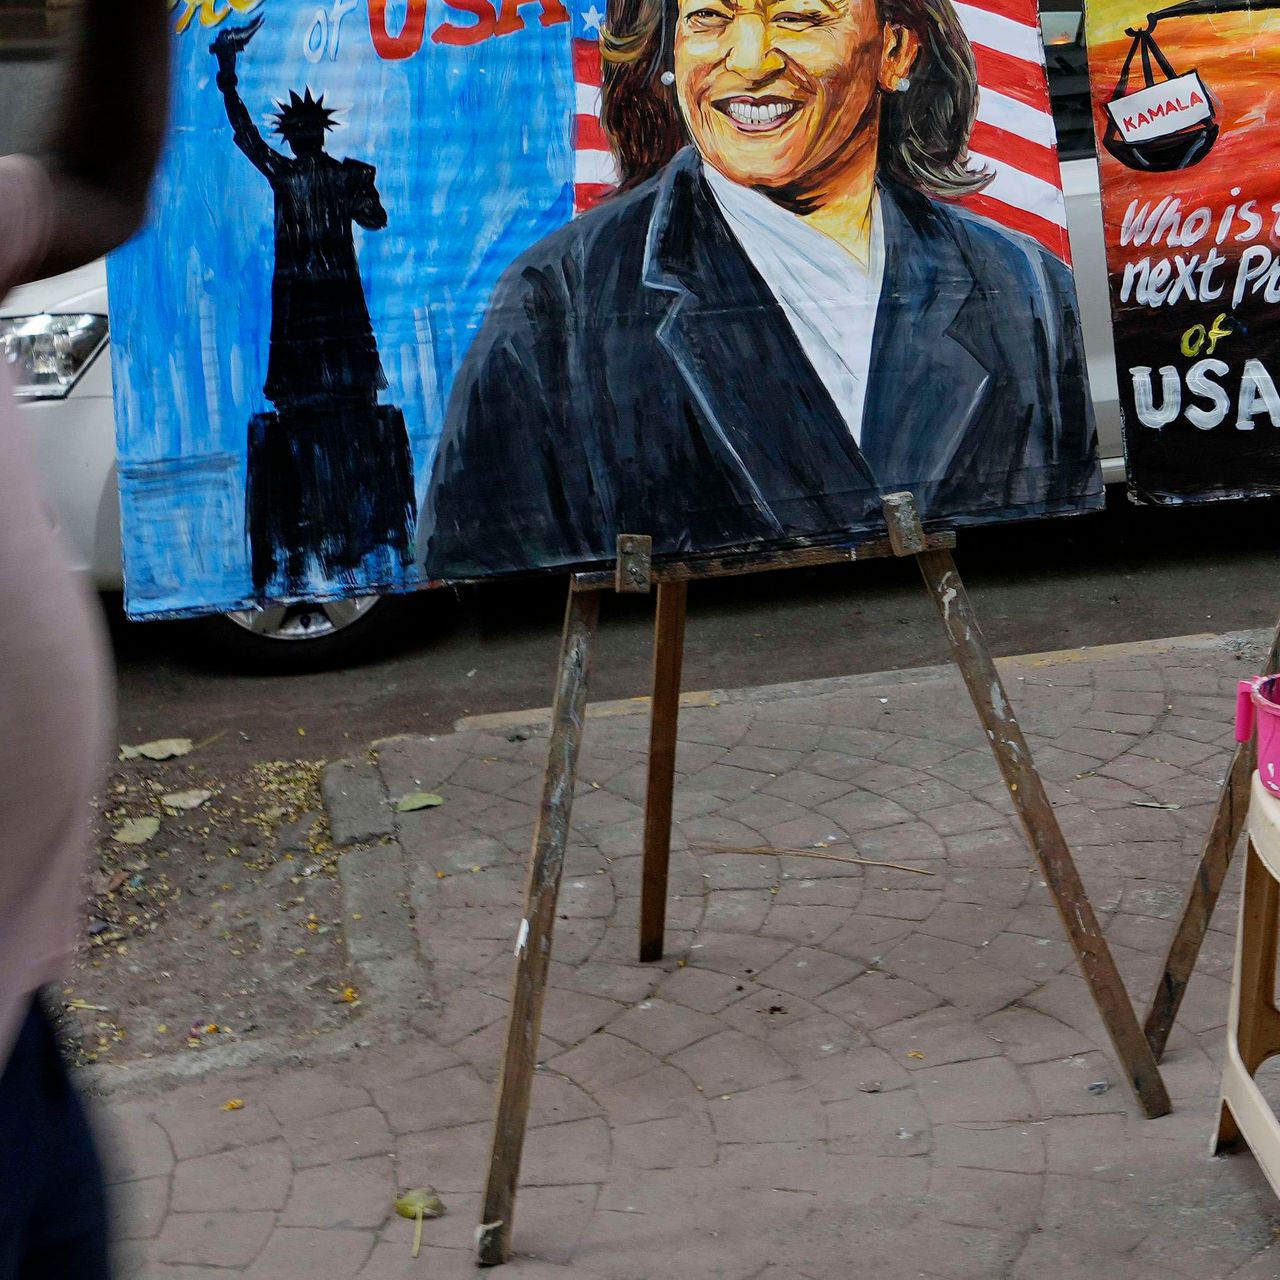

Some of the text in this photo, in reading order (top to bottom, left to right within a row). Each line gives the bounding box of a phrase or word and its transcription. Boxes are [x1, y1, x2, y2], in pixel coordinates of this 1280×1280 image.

[1122, 90, 1204, 133] KAMALA
[1120, 195, 1213, 248] Who
[1216, 186, 1264, 245] is
[1120, 247, 1227, 308] next
[1180, 312, 1234, 358] of
